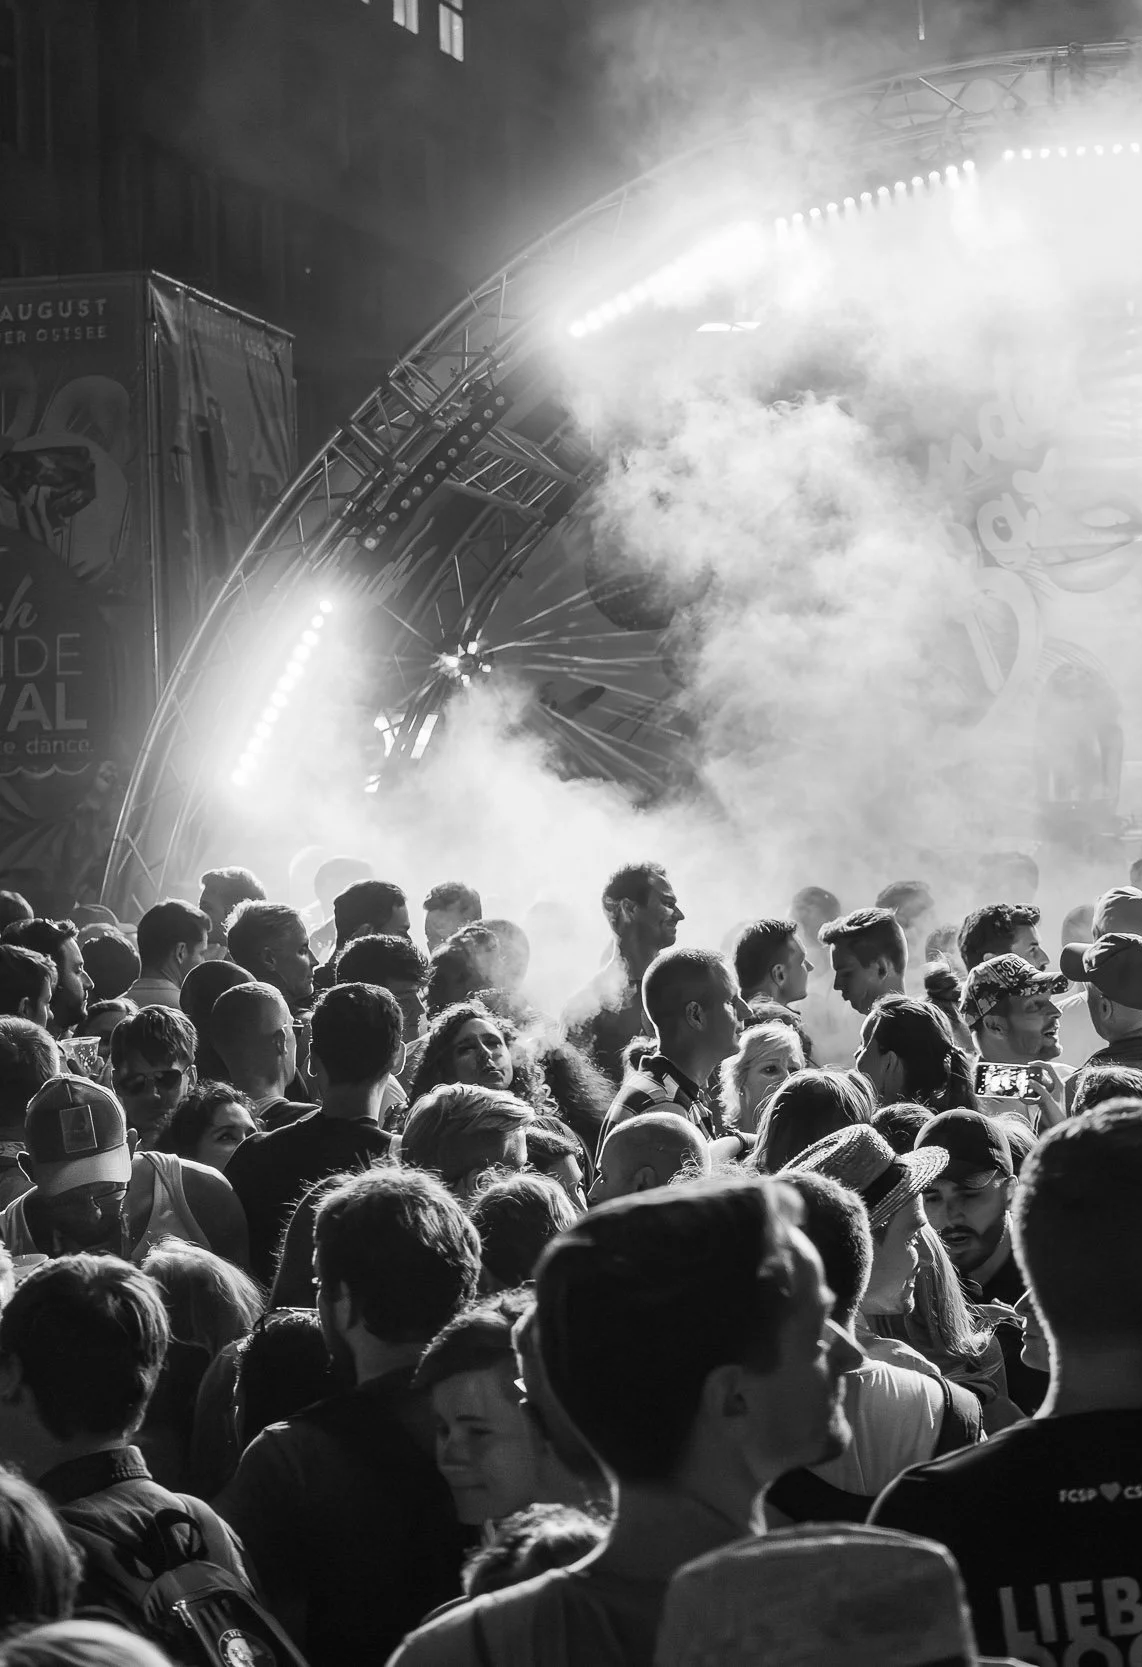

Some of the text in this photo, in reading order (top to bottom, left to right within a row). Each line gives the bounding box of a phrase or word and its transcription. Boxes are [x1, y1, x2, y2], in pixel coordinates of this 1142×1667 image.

[0, 298, 107, 322] AUGUST
[0, 325, 107, 345] ER OSTSEE
[0, 682, 88, 732] AL
[0, 738, 94, 754] e dance.
[1059, 1487, 1097, 1503] FCSP
